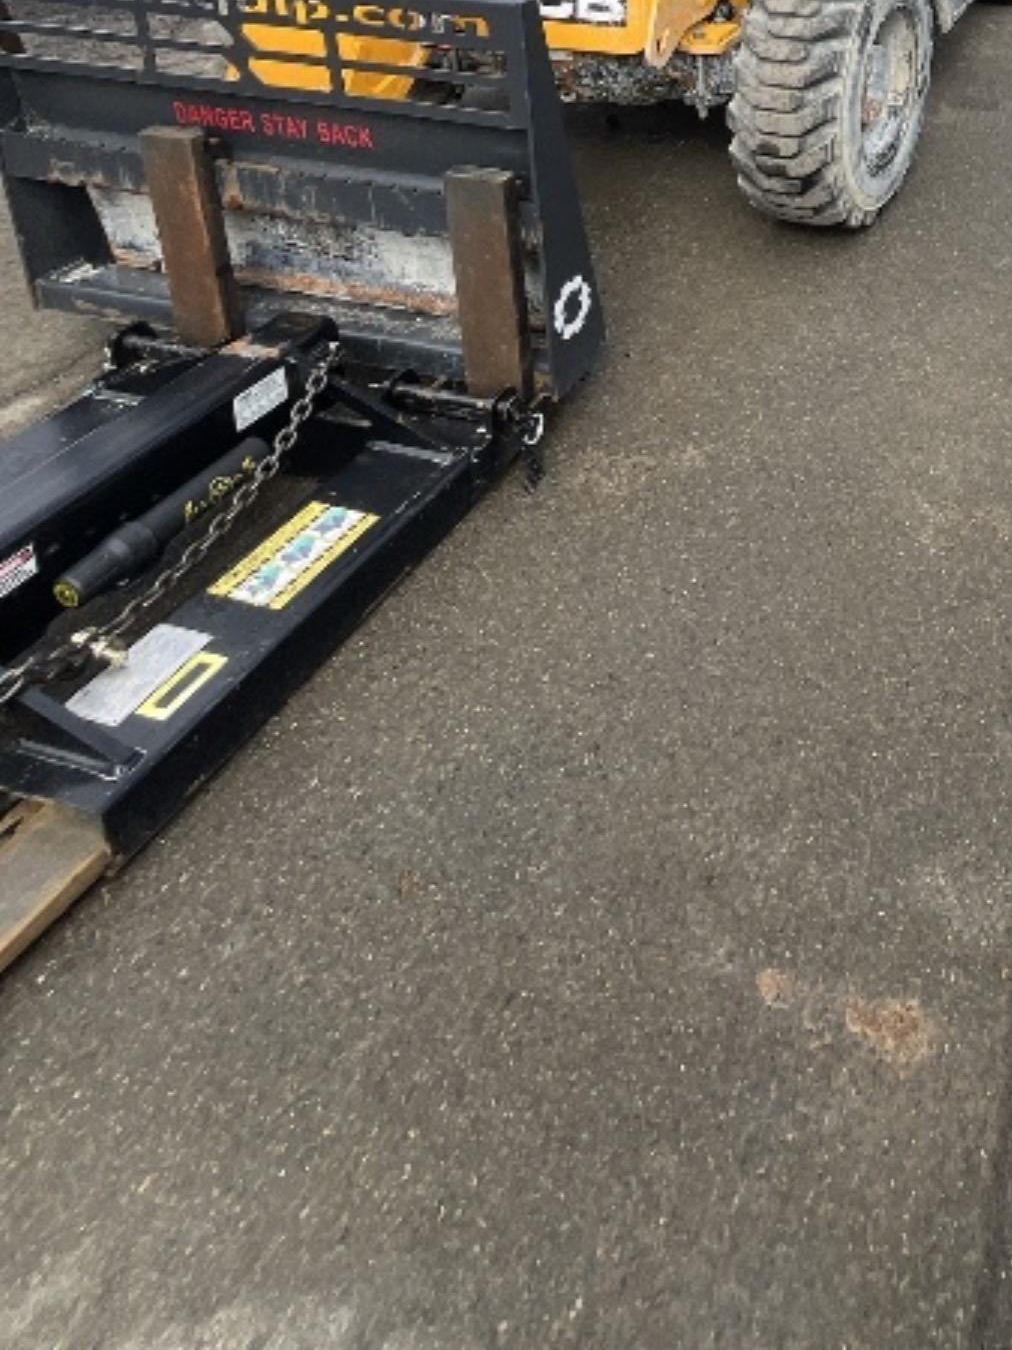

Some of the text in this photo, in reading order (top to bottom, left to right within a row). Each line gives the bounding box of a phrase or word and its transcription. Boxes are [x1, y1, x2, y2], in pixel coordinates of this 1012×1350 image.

[173, 101, 374, 149] DANGER STAY BACK
